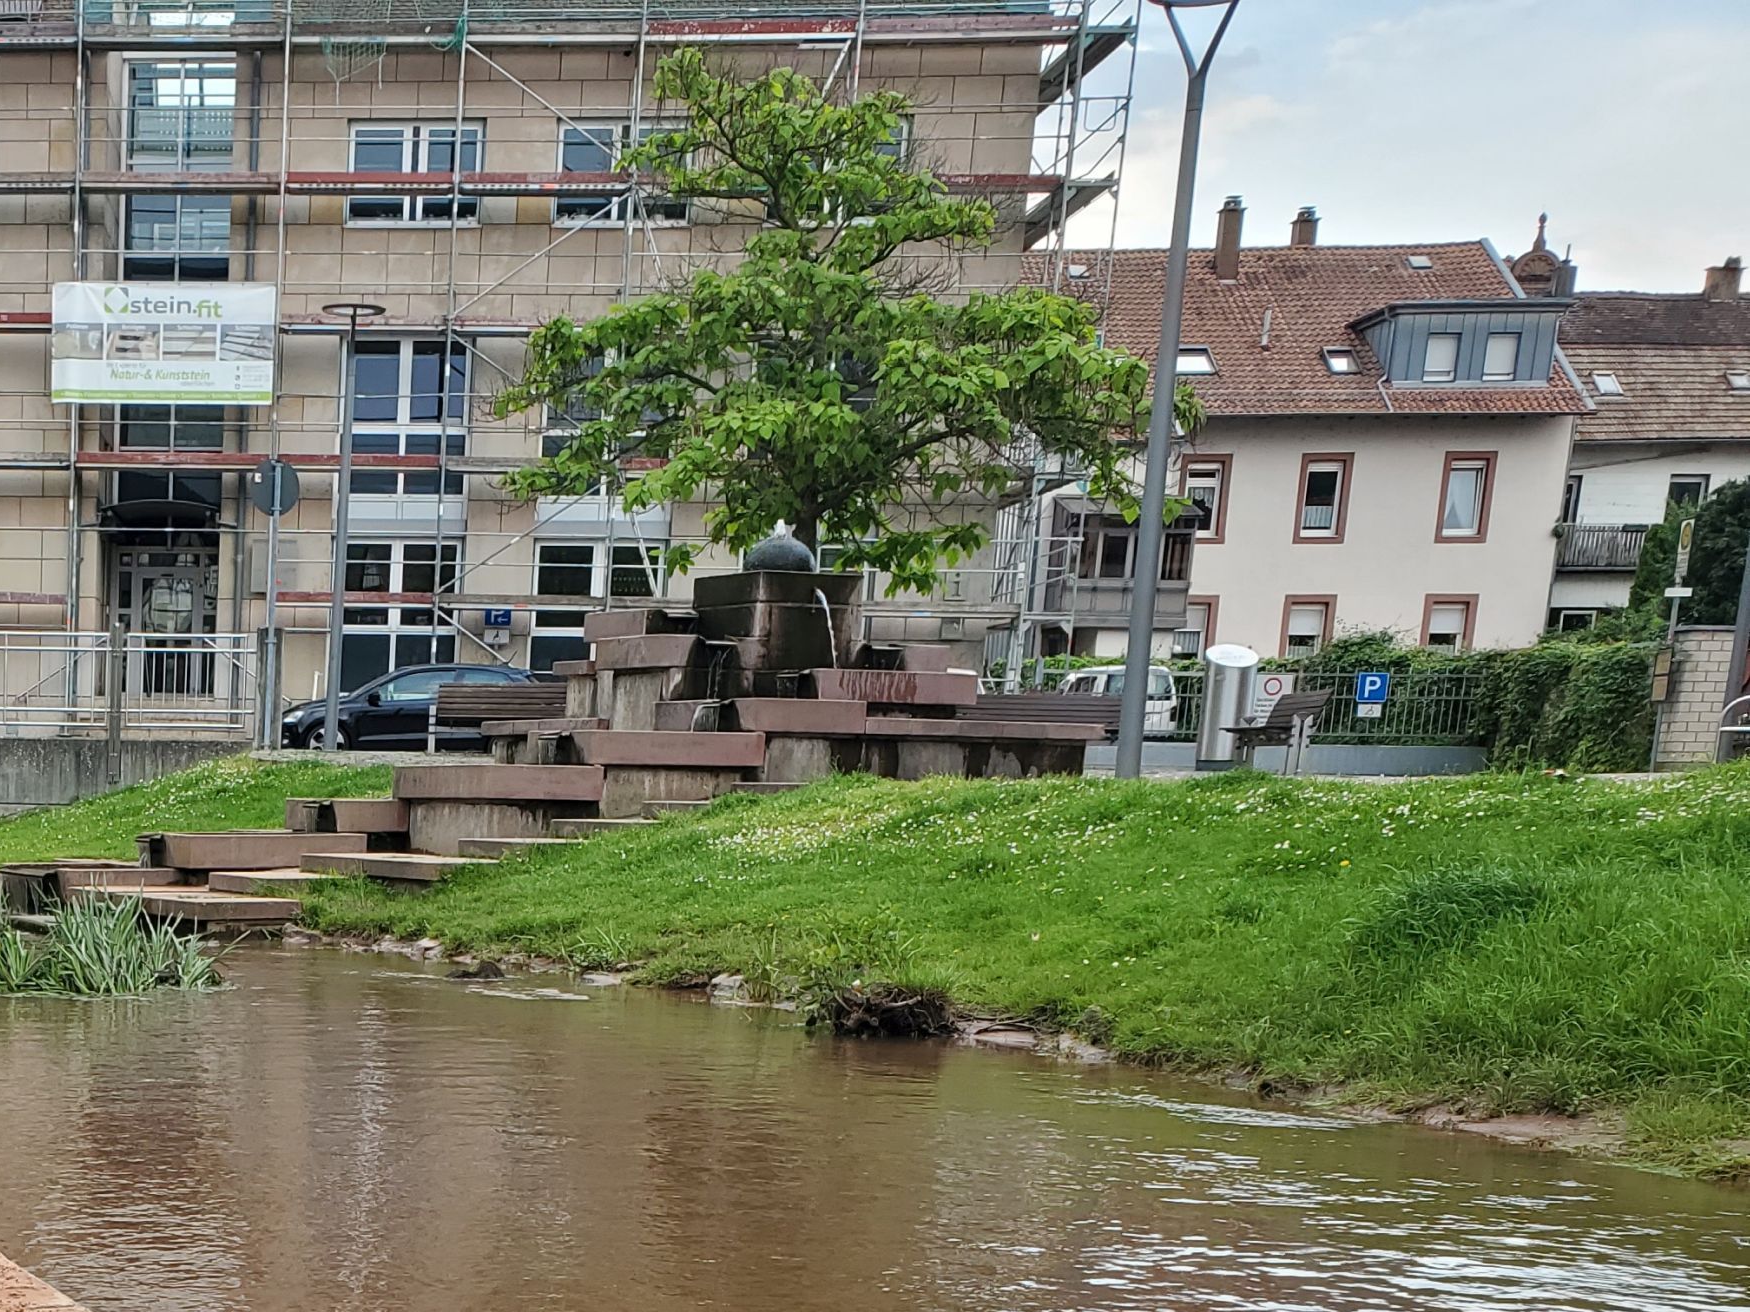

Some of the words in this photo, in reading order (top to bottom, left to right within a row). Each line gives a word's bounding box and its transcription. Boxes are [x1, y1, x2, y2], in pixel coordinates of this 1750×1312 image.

[130, 295, 223, 318] stein.fit
[155, 368, 211, 381] Kunststein
[1363, 676, 1382, 698] P
